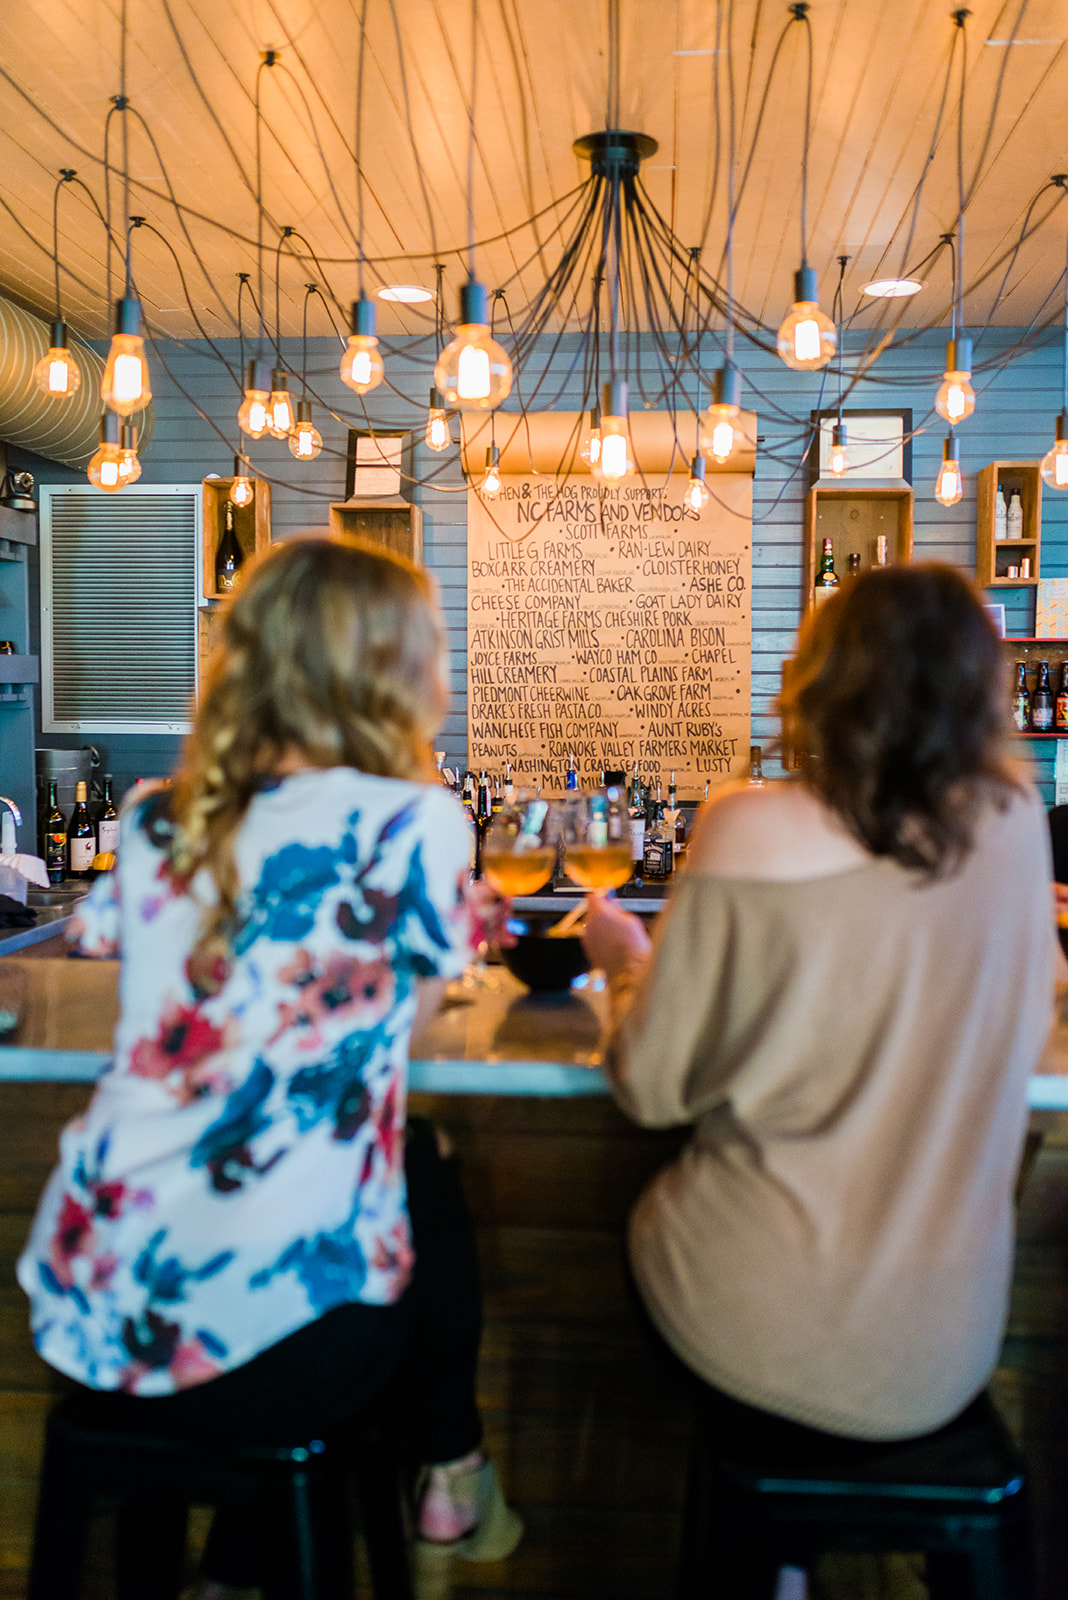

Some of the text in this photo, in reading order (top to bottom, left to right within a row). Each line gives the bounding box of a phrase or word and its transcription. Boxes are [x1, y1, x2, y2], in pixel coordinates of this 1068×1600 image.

[500, 485, 519, 501] HEN
[522, 483, 531, 499] &
[534, 484, 553, 499] THE
[556, 485, 577, 499] HOG
[581, 485, 620, 501] PROUDLY
[517, 501, 543, 522] NC
[547, 501, 596, 522] FARMS
[601, 504, 629, 522] AND
[566, 522, 648, 540] SCOTT FARMS
[488, 540, 525, 560] LITTLE
[544, 541, 583, 560] FARMS
[619, 540, 674, 559] RAN-LEW
[678, 540, 711, 558] DAIRY
[472, 561, 528, 577] BOXCARR
[530, 560, 595, 576] CREAMERY
[504, 576, 746, 593] THE ACCIDENTAL BAKER ASHE CO.
[471, 593, 742, 611] CHEESE COMPANY GOAT LADY DAIRY
[501, 611, 559, 628] HERITAGE
[562, 610, 602, 628] FARMS
[605, 610, 659, 628] CHESHIRE
[663, 611, 692, 627] PORK
[471, 627, 725, 650] ATKINSON GRIST MILLS CAROLINA BISON
[471, 648, 736, 666] JOYCE FARMS WAYCO HAM CO CHAPEL
[471, 665, 712, 684] HILL CREAMERY COASTAL PLAINS FARM
[473, 683, 711, 702] PIEDMONT CHEERWINE OAK GROVE FARM
[472, 704, 515, 719] DRAKE'S
[518, 703, 551, 719] FRESH
[556, 704, 585, 719] PASTA
[635, 701, 674, 718] WINDY
[678, 702, 711, 718] ACRES
[472, 722, 536, 739] WANCHESE
[539, 722, 563, 738] FISH
[566, 722, 618, 738] COMPANY
[648, 722, 683, 737] AUNT
[472, 739, 738, 758] PEANUTS ROANOKE VALLEY FARMERS MARKET
[507, 759, 580, 773] WASHINGTON
[584, 759, 611, 772] CRAB
[620, 759, 660, 773] SEAFOOD
[696, 758, 731, 773] LUSTY
